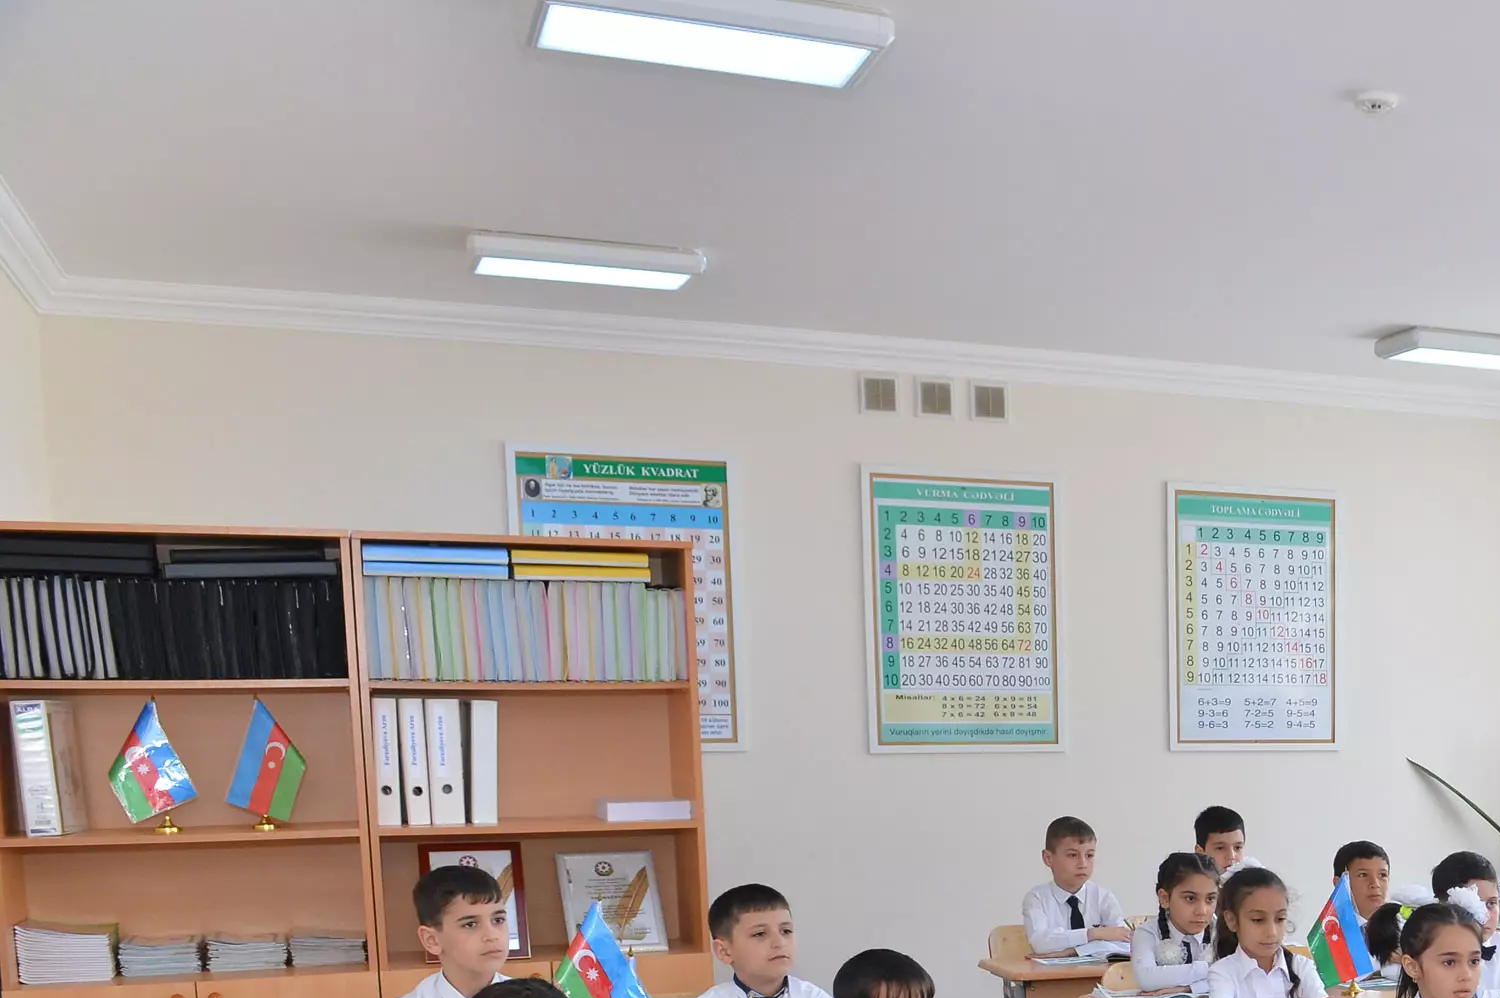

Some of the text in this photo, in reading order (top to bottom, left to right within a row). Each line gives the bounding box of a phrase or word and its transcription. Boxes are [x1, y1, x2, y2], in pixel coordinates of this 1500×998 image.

[583, 463, 700, 478] YÜZLÜK KVADRAT
[916, 487, 959, 499] VURMA
[1210, 505, 1257, 516] TOPLAMA
[708, 515, 718, 524] 10
[885, 510, 1045, 528] 1 2 3 4 5 6 7 8 9 10
[690, 535, 700, 543] 19
[709, 535, 720, 544] 20
[884, 527, 1046, 546] 2 4 6 8 10 12 14 16 18 20
[1198, 526, 1323, 544] 1 2 3 4 5 6 7 8 9
[884, 545, 1047, 563] 3 6 9 12 15 18 21 24 27 30
[1186, 544, 1324, 560] 1 2 3 4 5 6 7 8 9 10
[710, 556, 721, 564] 30
[884, 564, 1046, 581] 4 8 12 16 20 24 28 32 36 40
[1186, 560, 1322, 575] 2 3 4 5 6 7 8 9 10 11
[885, 582, 1046, 598] 5 10 15 20 25 30 35 40 45 50
[712, 597, 723, 605] 50
[712, 618, 724, 626] 60
[714, 639, 725, 647] 70
[715, 680, 727, 688] 90
[713, 700, 729, 708] 100
